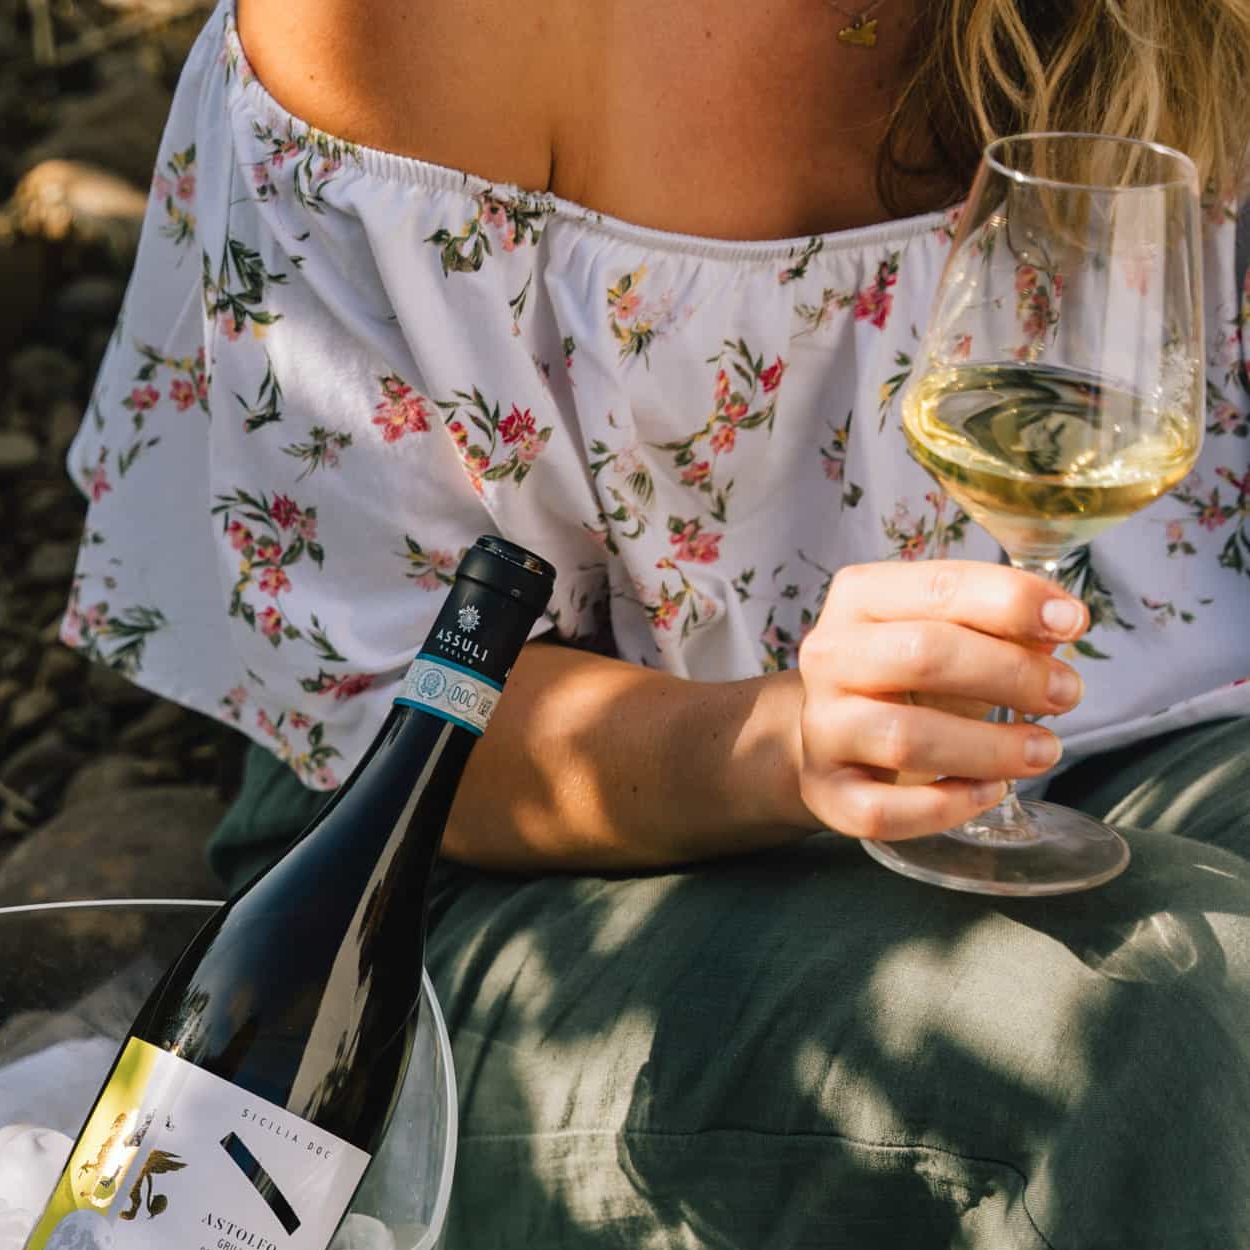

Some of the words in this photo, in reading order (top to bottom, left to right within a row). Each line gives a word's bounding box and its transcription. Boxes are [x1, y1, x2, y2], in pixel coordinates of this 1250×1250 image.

[436, 628, 489, 662] ASSULI
[451, 685, 477, 708] DOC
[241, 1108, 299, 1143] SICILIA
[306, 1141, 332, 1160] DOC
